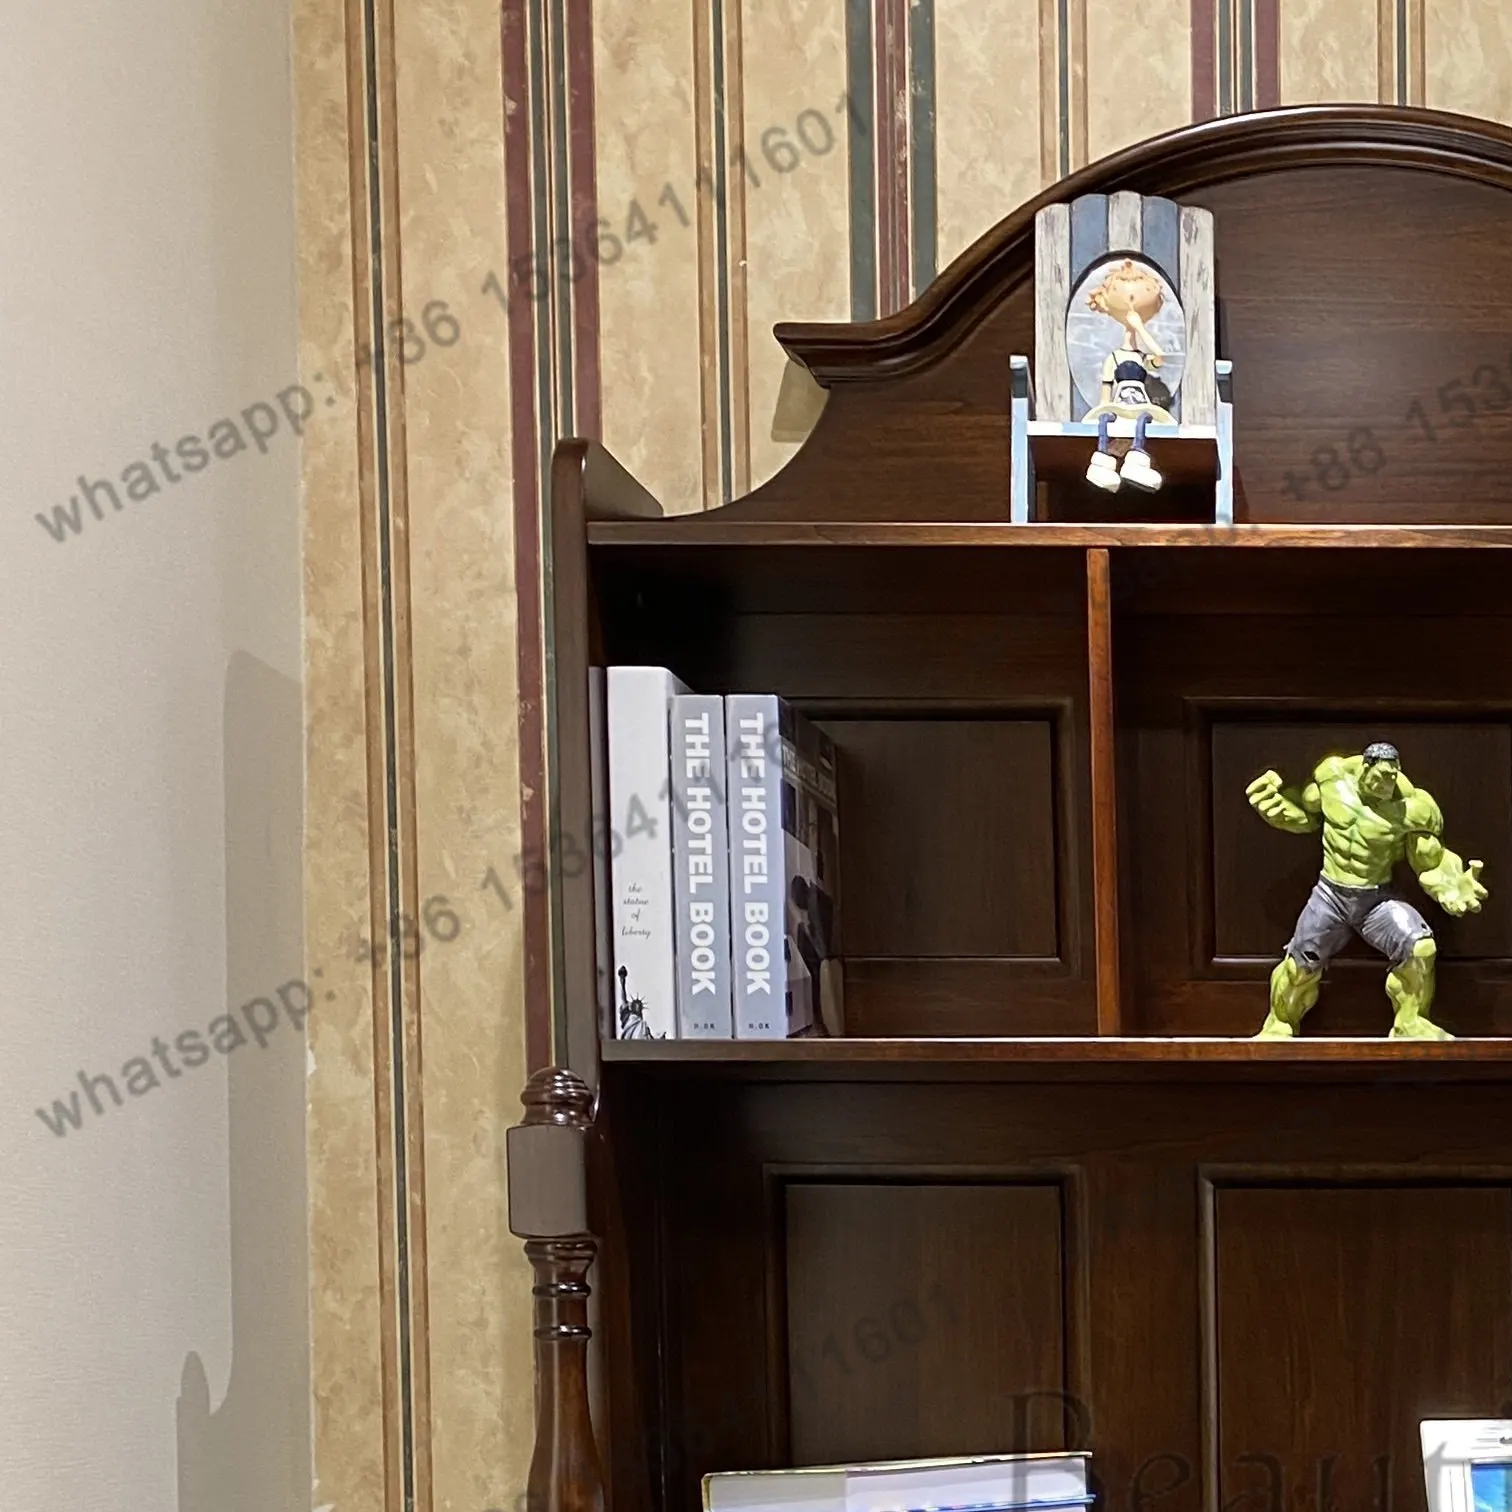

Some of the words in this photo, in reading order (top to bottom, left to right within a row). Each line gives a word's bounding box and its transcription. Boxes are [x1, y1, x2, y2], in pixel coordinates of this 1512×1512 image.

[685, 711, 711, 779] THE
[740, 711, 767, 779] THE
[687, 786, 714, 895] HOTEL
[742, 786, 769, 895] HOTEL
[689, 901, 717, 996] BOOK
[744, 901, 772, 996] BOOK
